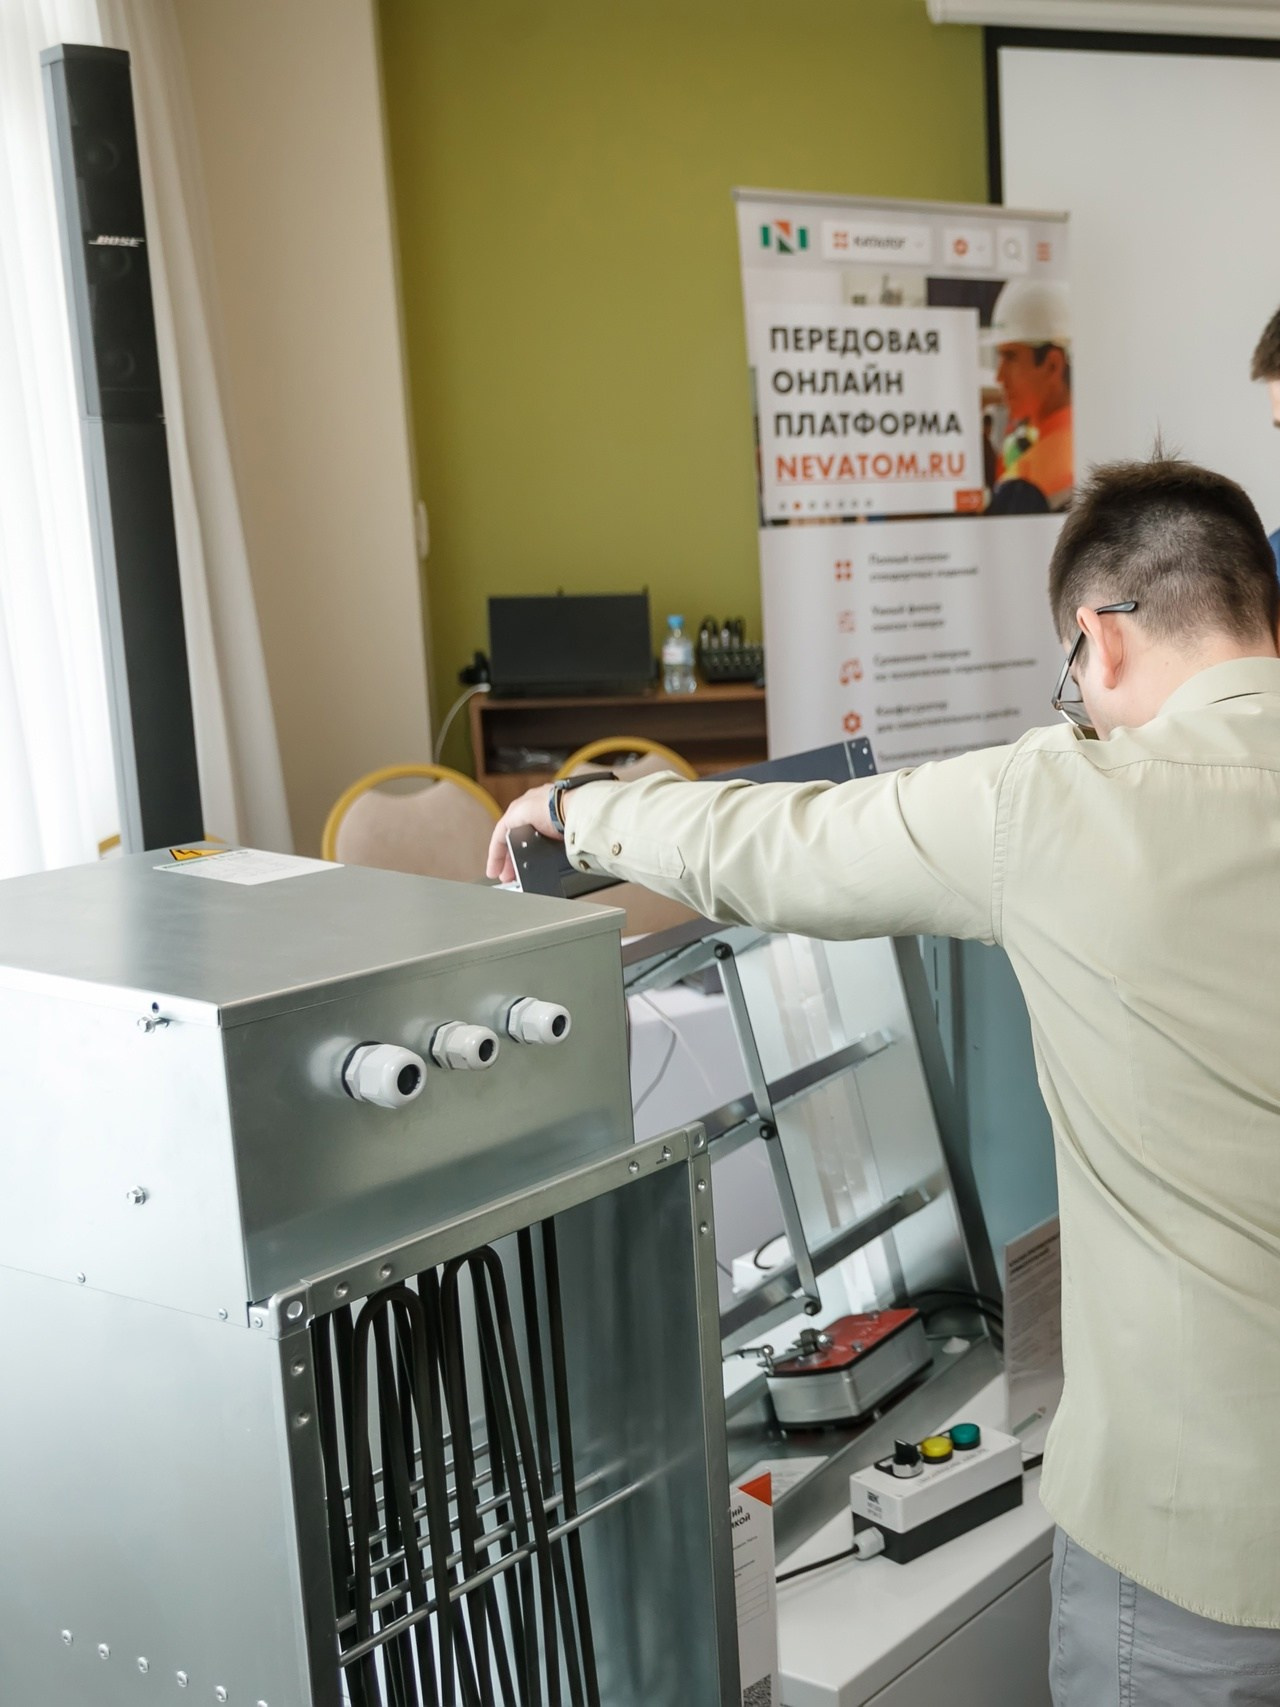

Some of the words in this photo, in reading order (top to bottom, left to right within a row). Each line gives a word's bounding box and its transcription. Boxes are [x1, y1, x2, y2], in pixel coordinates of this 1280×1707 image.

[88, 234, 144, 248] BOSE
[770, 327, 940, 356] ПЕРЕДОВАЯ
[772, 364, 903, 394] ОНЛАЙН
[774, 410, 964, 437] ПЛАТФОРМА
[775, 453, 967, 482] NEVATOM.RU
[731, 1512, 751, 1529] кой
